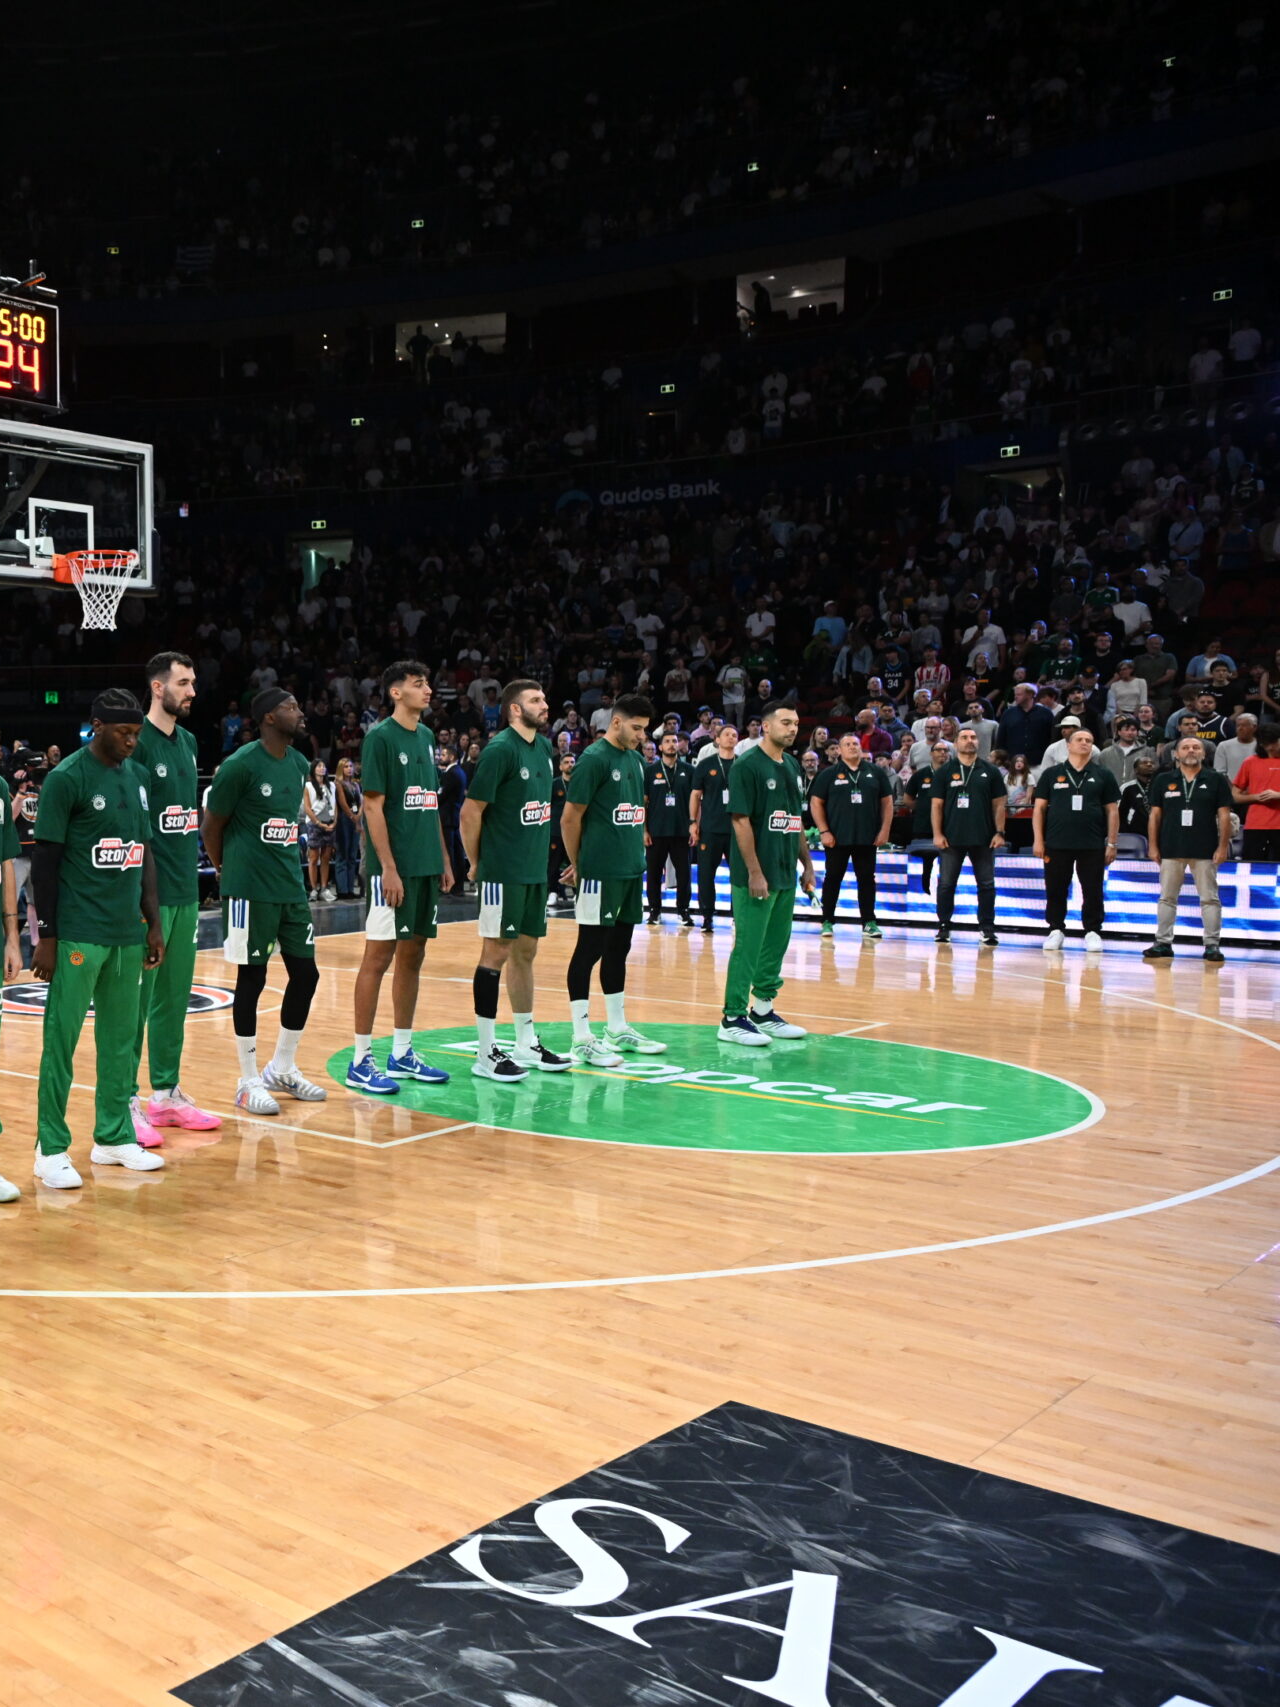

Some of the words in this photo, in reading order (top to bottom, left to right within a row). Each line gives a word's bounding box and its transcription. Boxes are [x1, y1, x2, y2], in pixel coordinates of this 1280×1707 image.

[0, 308, 45, 343] 5:00
[599, 486, 666, 506] Qudos
[668, 479, 721, 499] Bank
